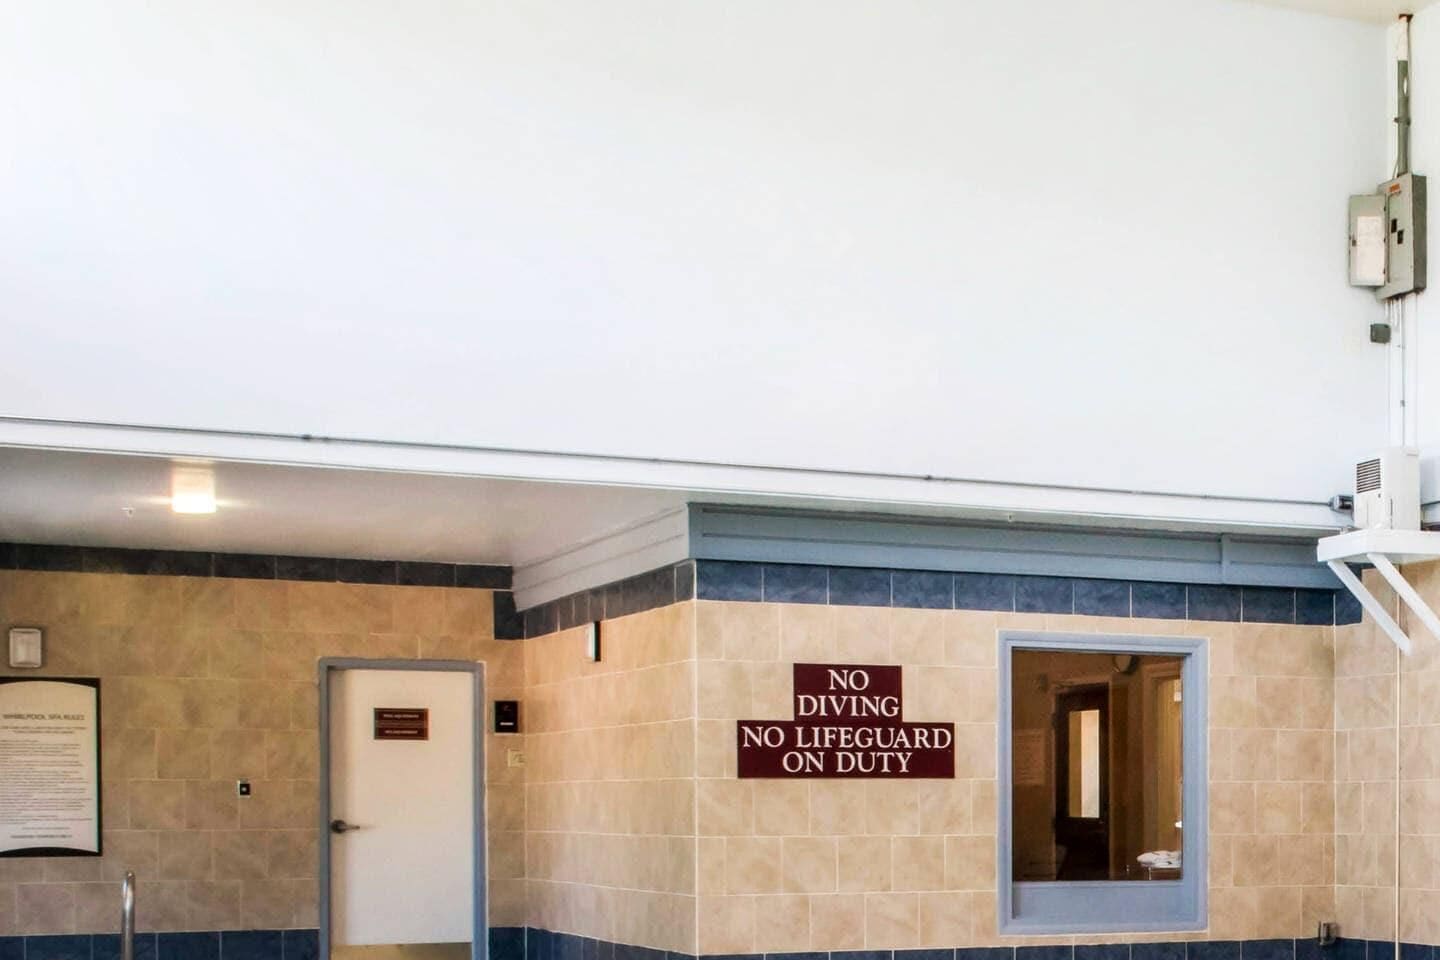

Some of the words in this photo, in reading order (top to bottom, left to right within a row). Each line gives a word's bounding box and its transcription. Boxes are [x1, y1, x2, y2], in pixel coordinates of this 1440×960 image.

[828, 669, 870, 691] NO
[797, 694, 900, 717] DIVING
[741, 726, 785, 748] NO
[795, 726, 952, 749] LIFEGUARD
[782, 750, 825, 773] ON
[836, 751, 913, 773] DUTY
